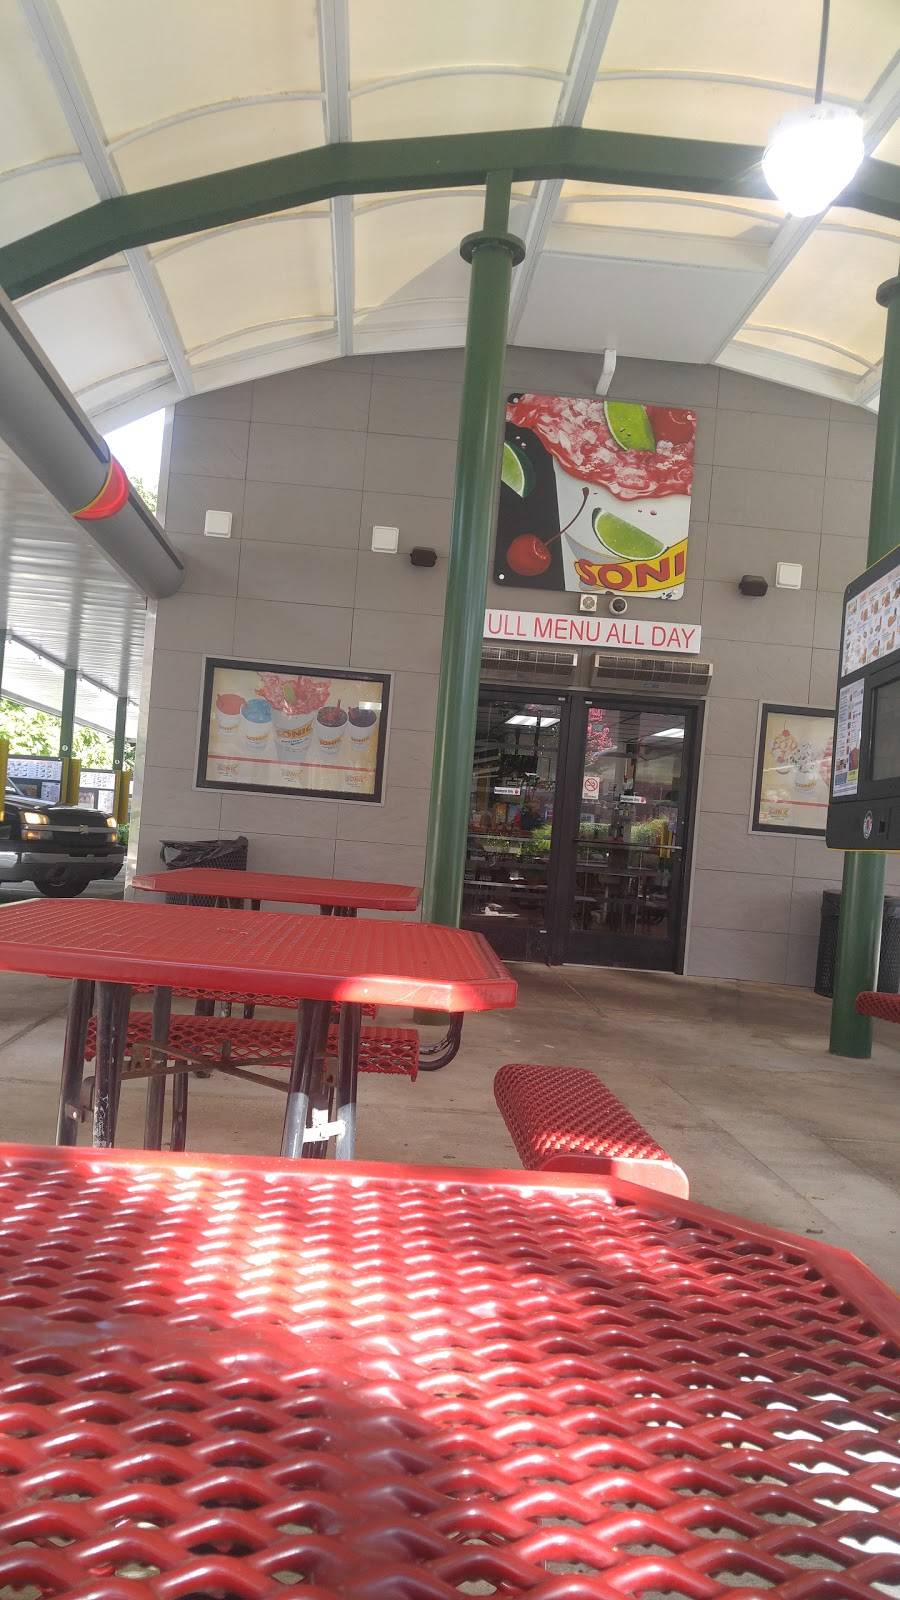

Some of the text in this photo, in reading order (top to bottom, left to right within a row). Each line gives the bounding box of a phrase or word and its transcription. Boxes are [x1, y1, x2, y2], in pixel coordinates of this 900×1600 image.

[578, 550, 685, 591] SONI
[487, 613, 696, 649] ULL MENU ALL DAY
